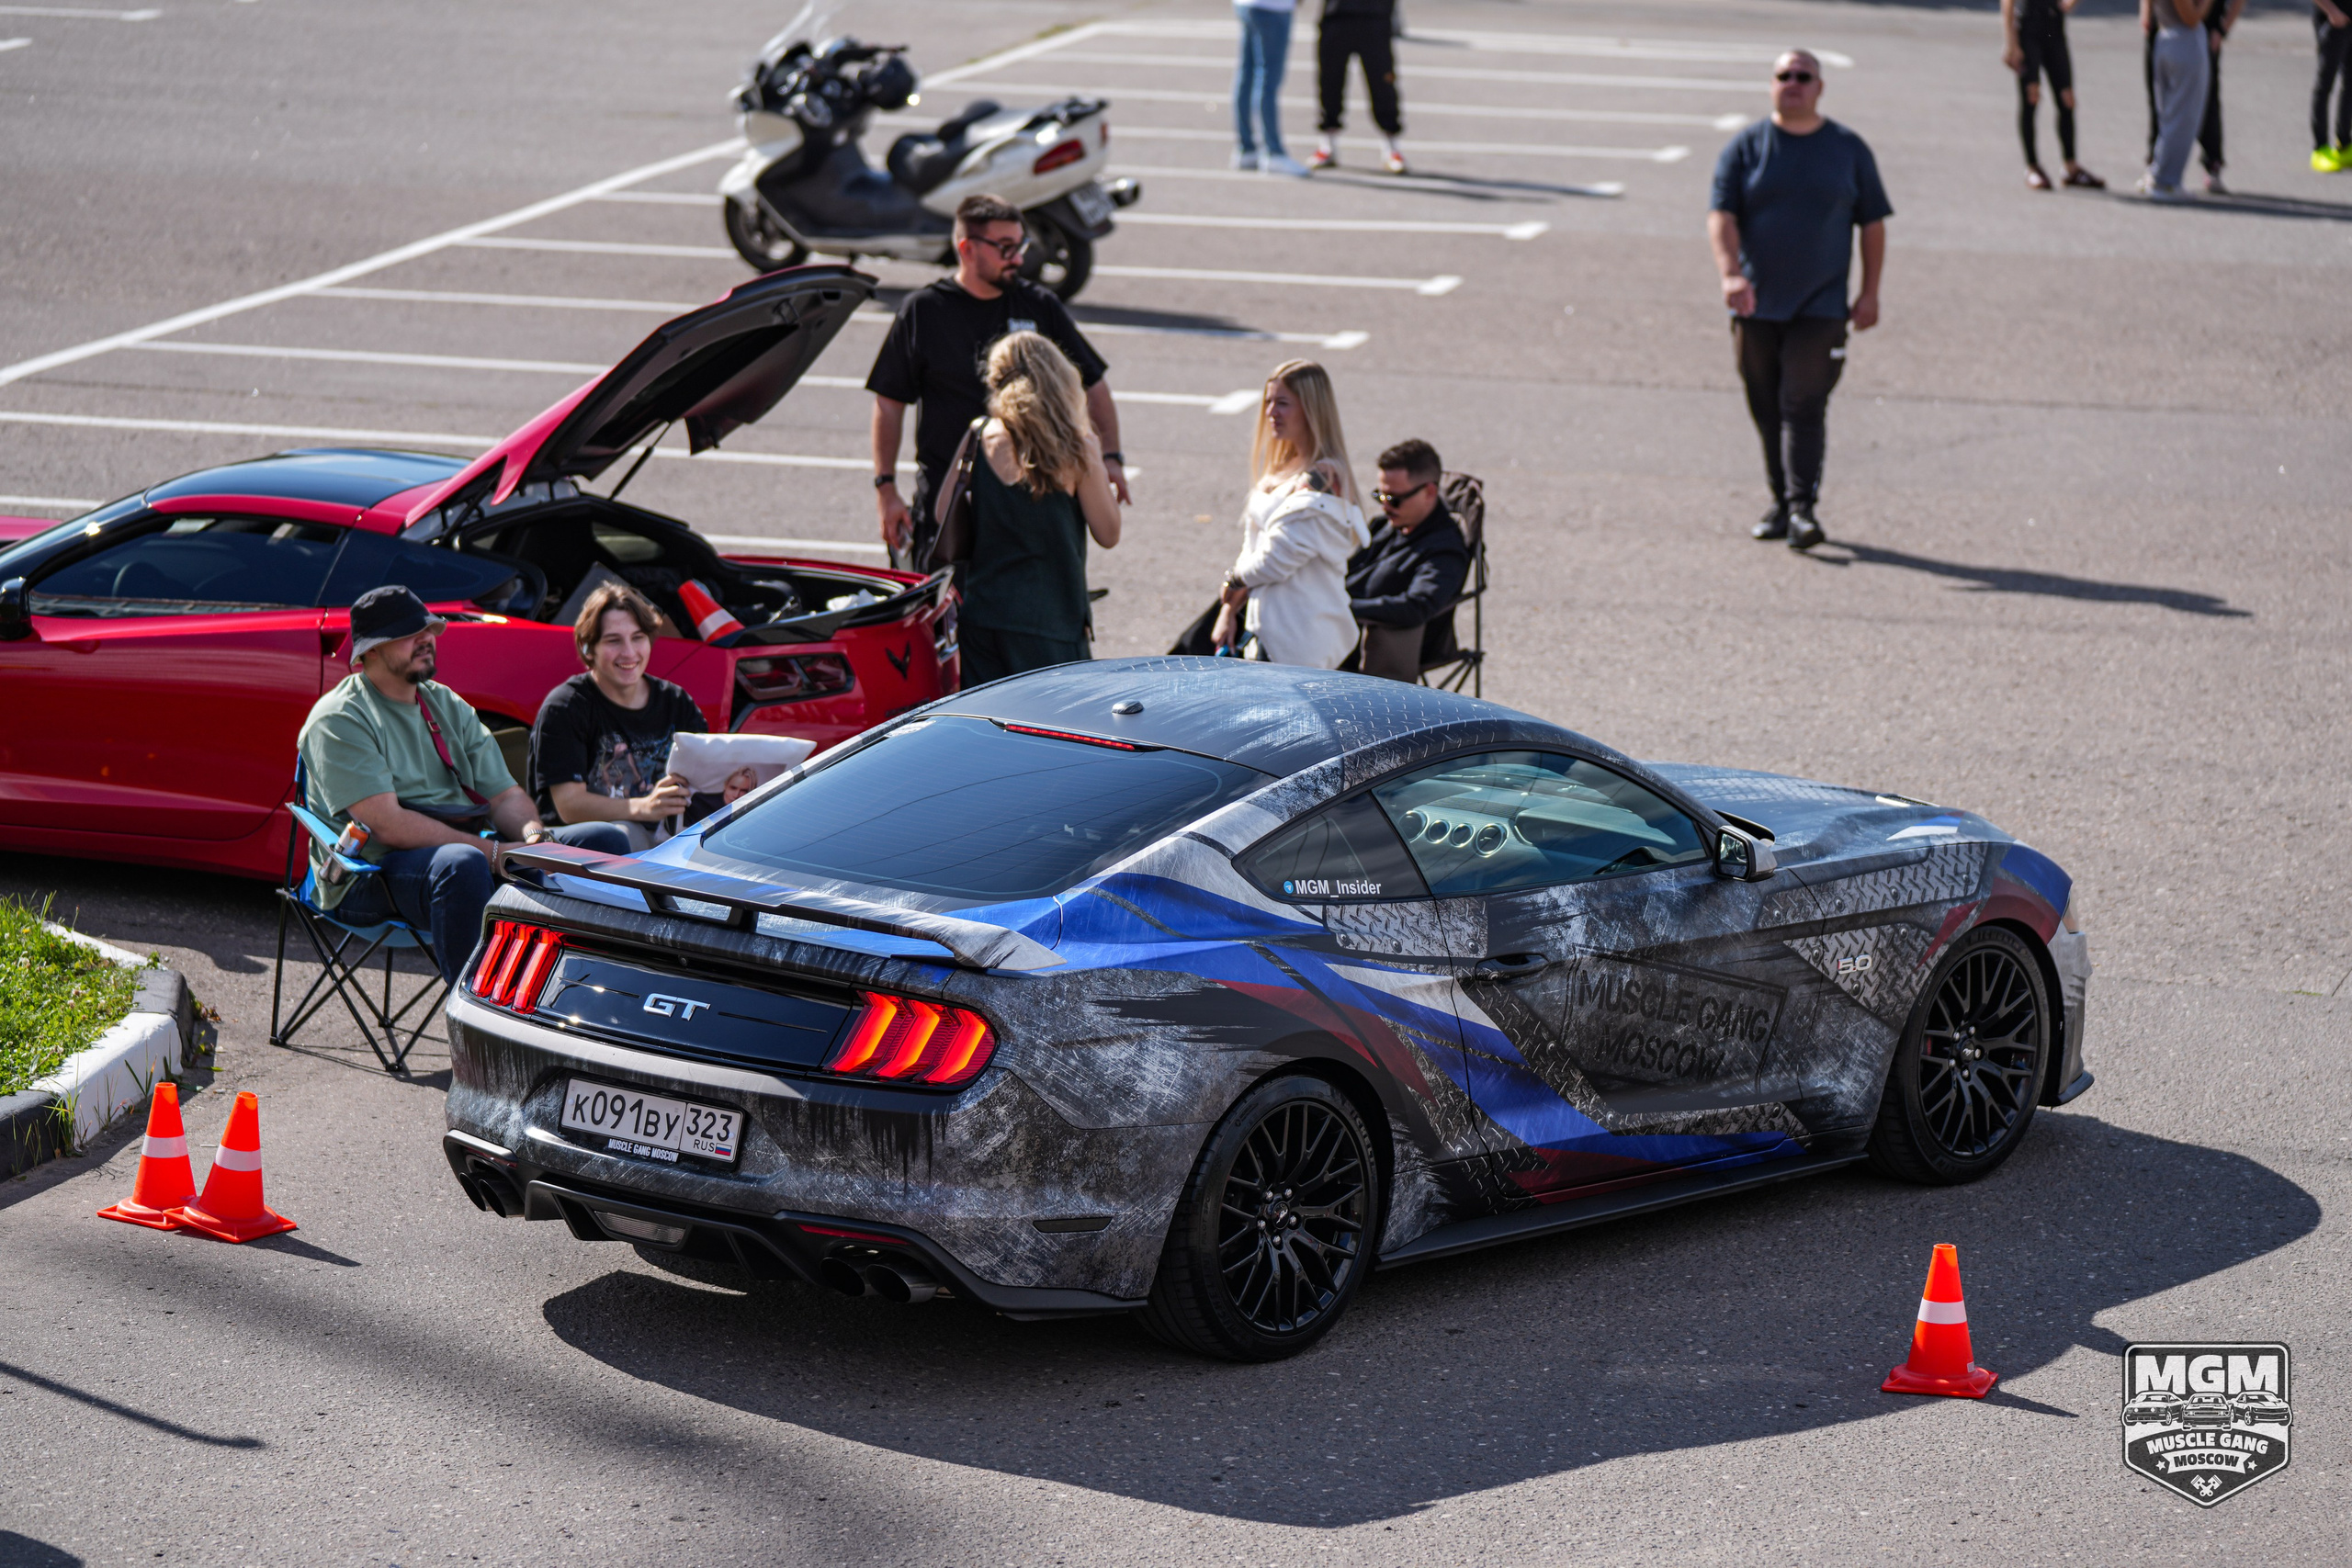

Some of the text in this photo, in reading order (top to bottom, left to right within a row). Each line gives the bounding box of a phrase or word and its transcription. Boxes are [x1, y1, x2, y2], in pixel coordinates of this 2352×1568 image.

[1295, 879, 1382, 897] MGM_Insider
[1838, 954, 1872, 975] 5.0
[643, 993, 711, 1021] GT
[1577, 970, 1770, 1043] MUSCLE GANG
[1597, 1027, 1725, 1082] MOSCOW
[686, 1108, 733, 1141] 323
[608, 1138, 679, 1163] MUSCLE GANG MOSCOW
[693, 1139, 716, 1152] RUS
